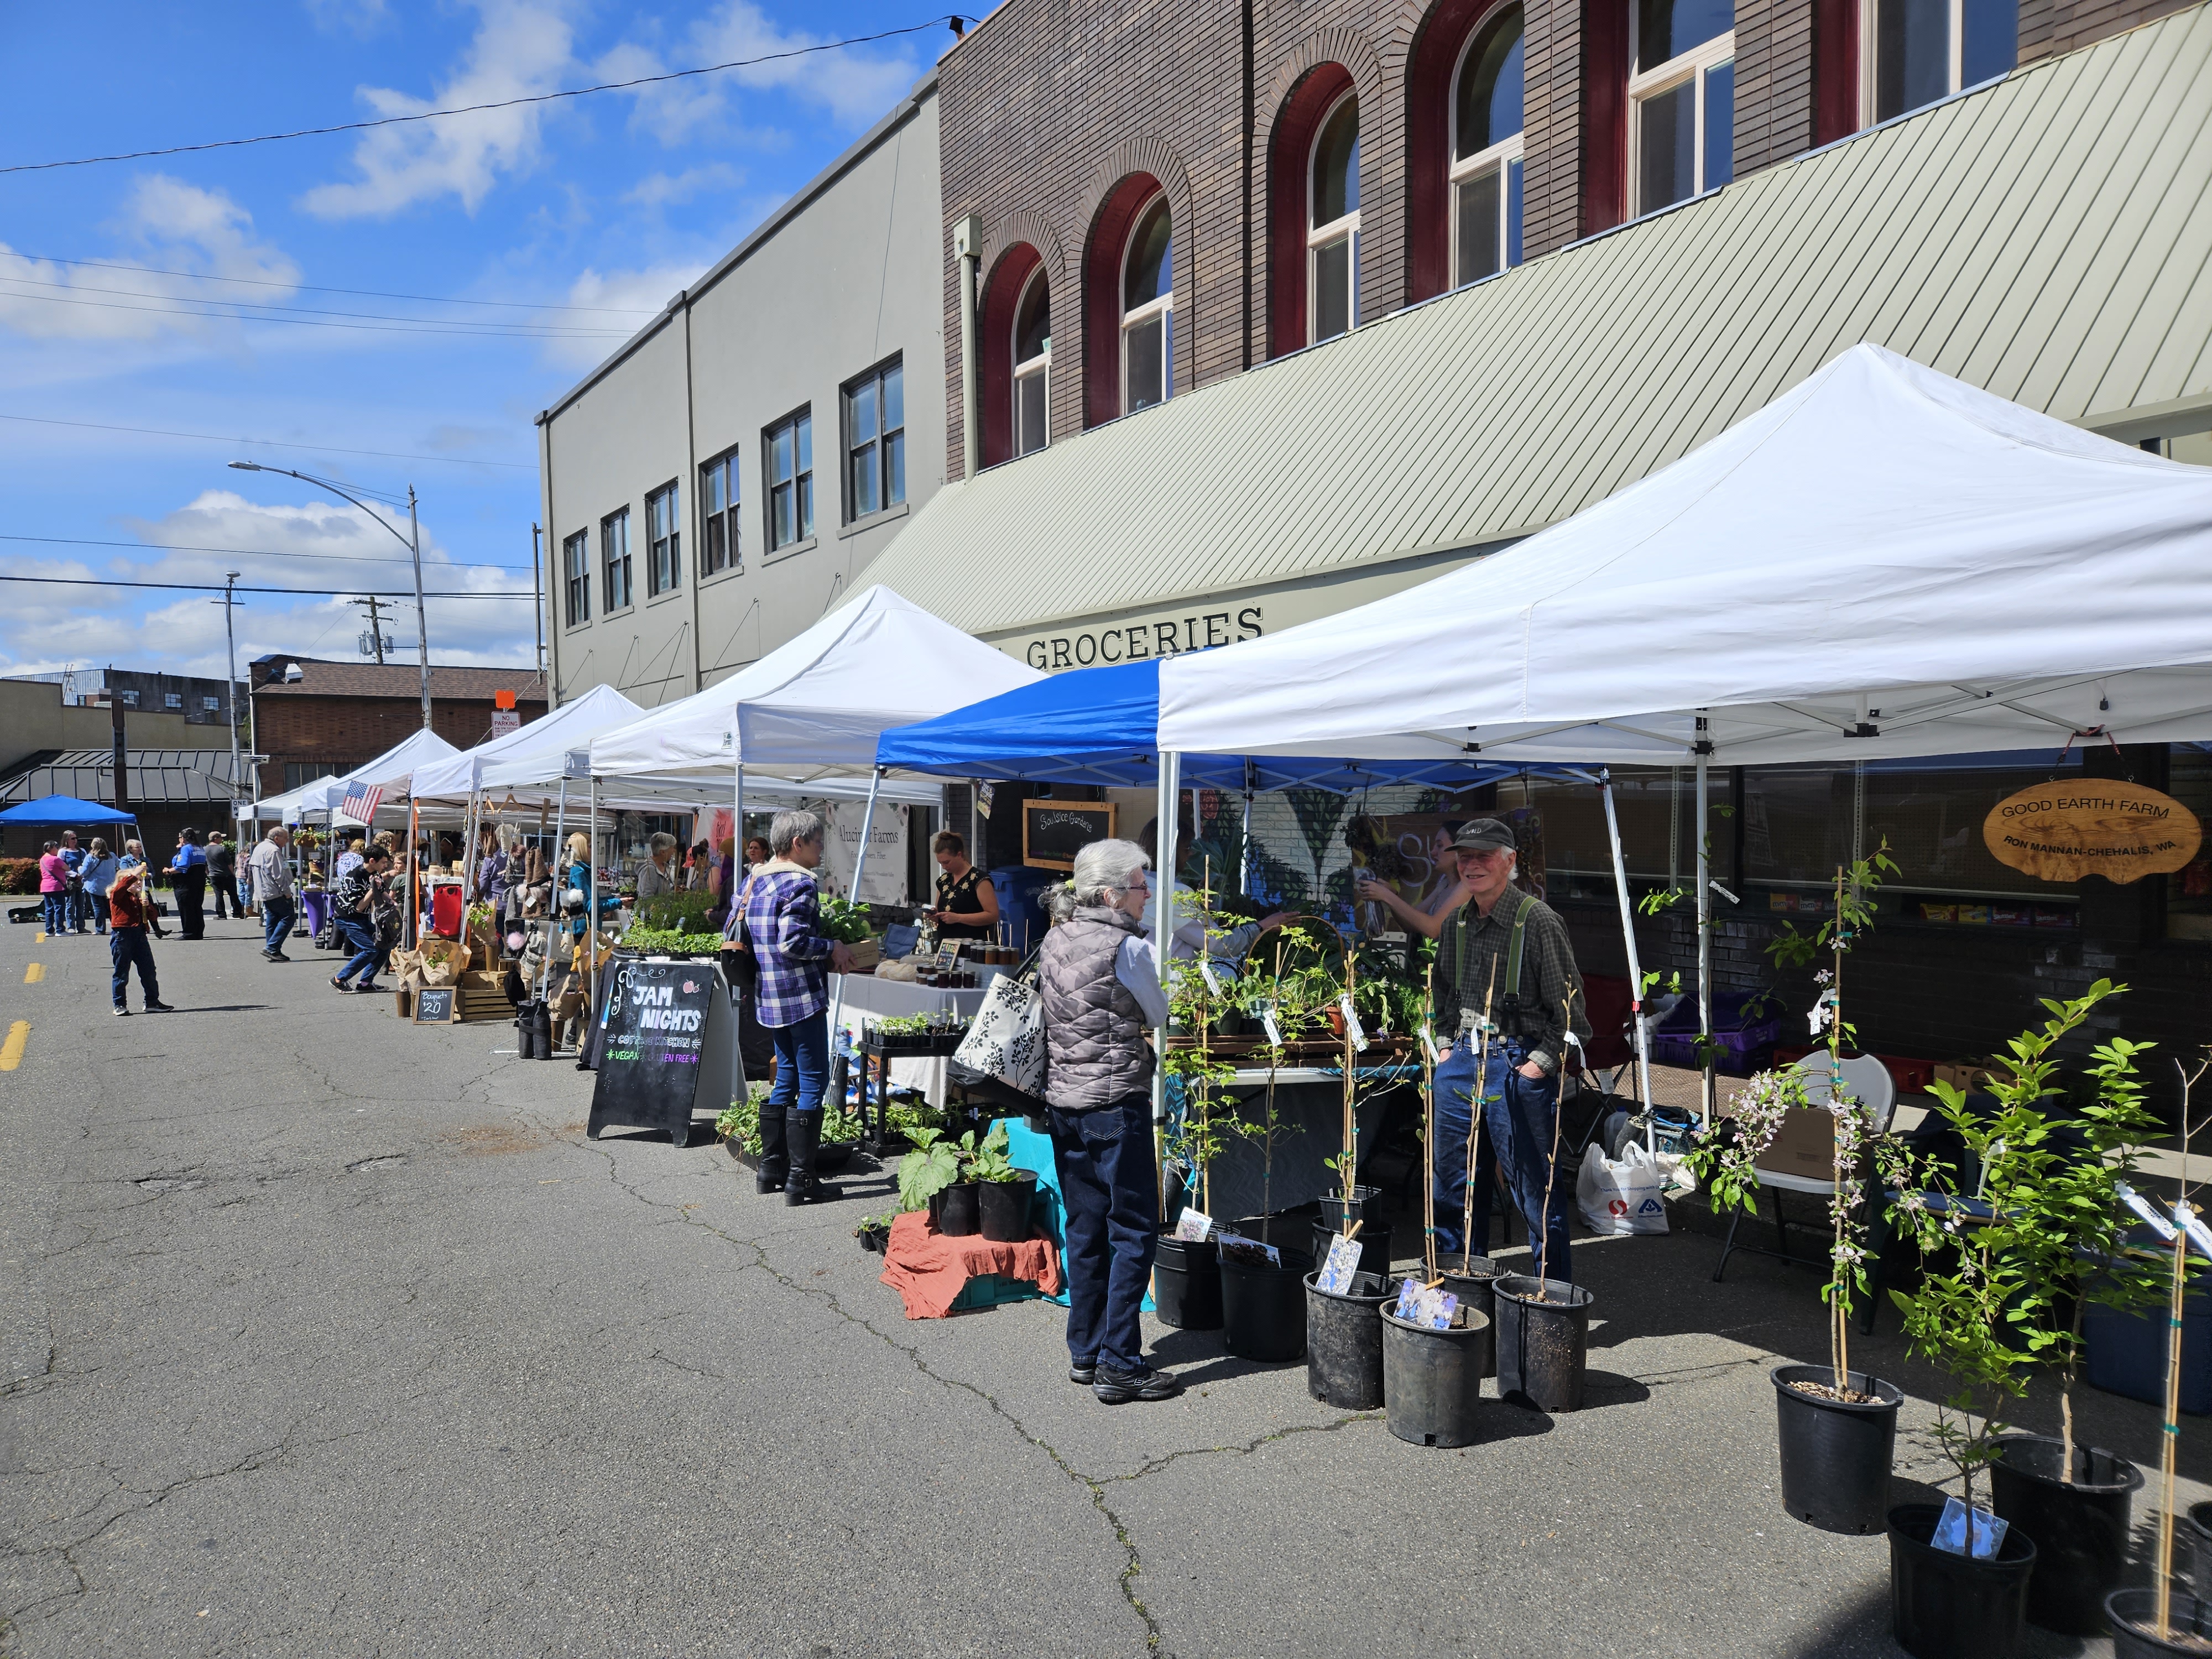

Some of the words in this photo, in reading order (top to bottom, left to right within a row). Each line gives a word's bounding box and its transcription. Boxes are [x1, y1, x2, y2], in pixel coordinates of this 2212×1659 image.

[1027, 607, 1264, 671] GROCERIES
[2002, 800, 2052, 818] GOOD
[2058, 798, 2114, 810] EARTH
[2120, 800, 2170, 819] FARM
[1040, 811, 1068, 830] Soulsice
[1069, 812, 1093, 833] Gardens
[873, 827, 899, 843] Farms
[2003, 836, 2028, 849] RON
[2030, 843, 2153, 857] MANNAN-CHEHALIS,
[2156, 840, 2177, 852] WA
[422, 992, 447, 1003] Bouquets
[633, 986, 674, 1006] JAM
[423, 1001, 441, 1014] $20
[640, 1009, 702, 1032] NIGHTS
[618, 1035, 653, 1045] COTTAGE
[655, 1036, 690, 1047] KITCHEN
[615, 1051, 640, 1060] VEGAN
[648, 1052, 674, 1062] GLUTEN
[675, 1054, 690, 1063] FREE
